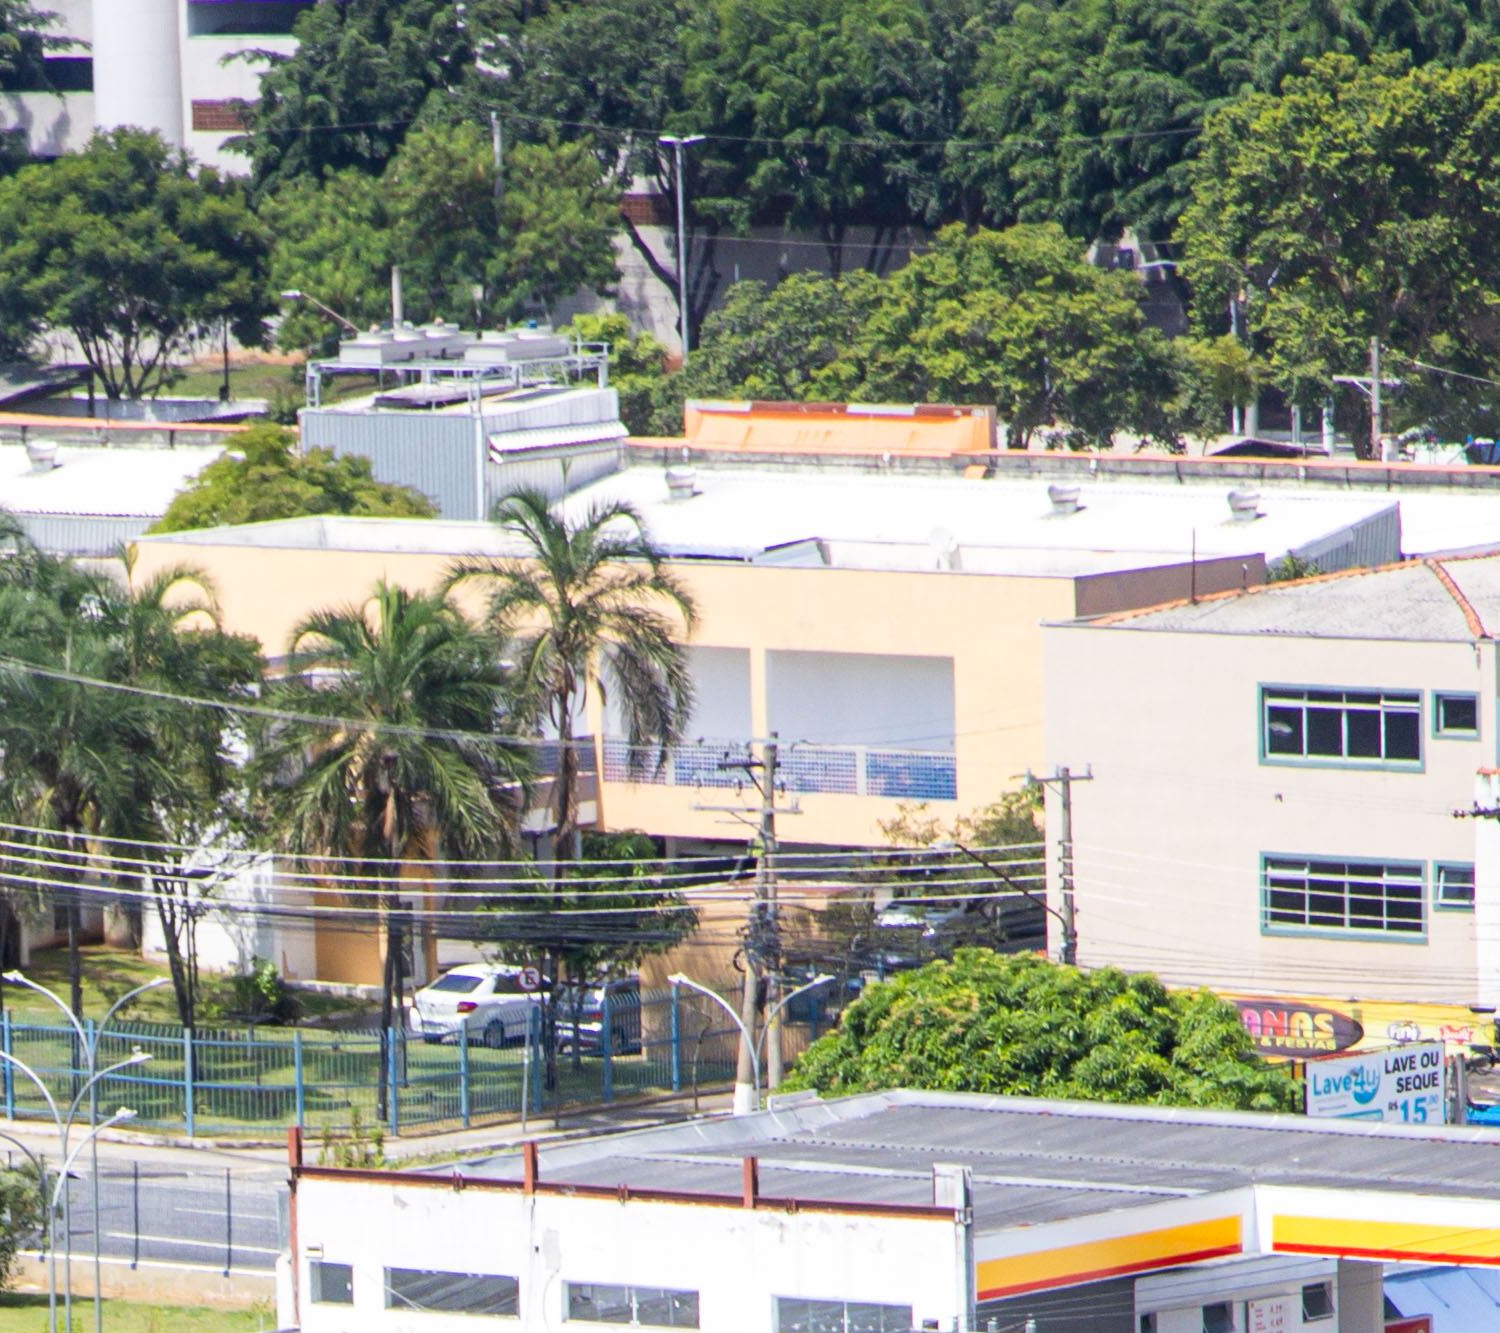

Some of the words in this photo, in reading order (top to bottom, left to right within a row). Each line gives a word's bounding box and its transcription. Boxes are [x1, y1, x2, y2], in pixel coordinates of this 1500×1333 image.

[1242, 1008, 1334, 1038] ANAS
[1384, 1054, 1416, 1075] LAVE
[1419, 1051, 1439, 1068] OU
[1395, 1072, 1439, 1094] SEQUE
